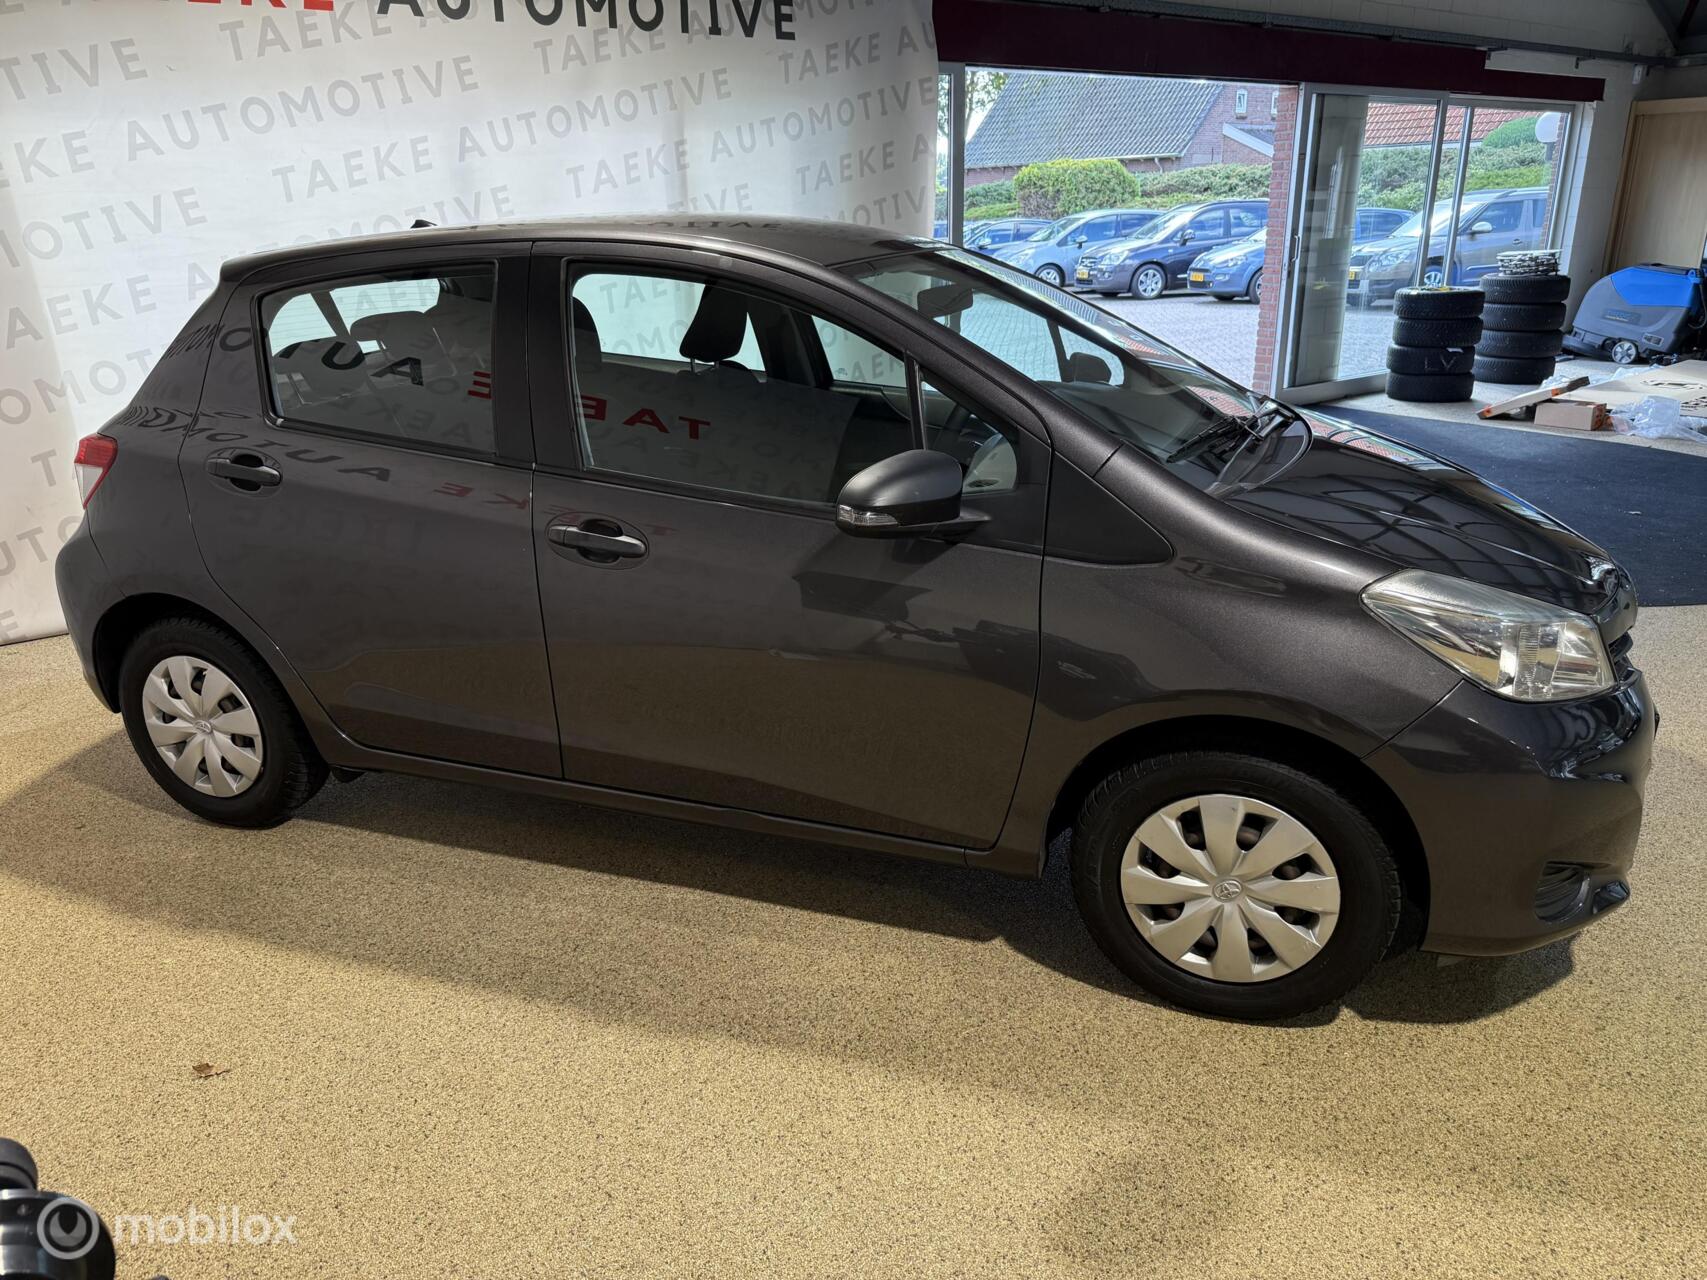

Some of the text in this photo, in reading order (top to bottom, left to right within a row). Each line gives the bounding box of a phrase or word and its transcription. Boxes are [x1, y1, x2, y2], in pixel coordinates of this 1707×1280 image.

[127, 55, 479, 162] AUTOMOTIVE
[534, 23, 666, 74] TAEKE
[218, 0, 393, 62] TAEKE
[272, 135, 434, 203] TAEKE
[458, 67, 732, 163] AUTOMOTIVE
[778, 31, 881, 85] TAEKE
[566, 138, 691, 199] TAEKE
[709, 75, 934, 163] AUTOMOTIVE
[796, 140, 896, 196] TAEKE
